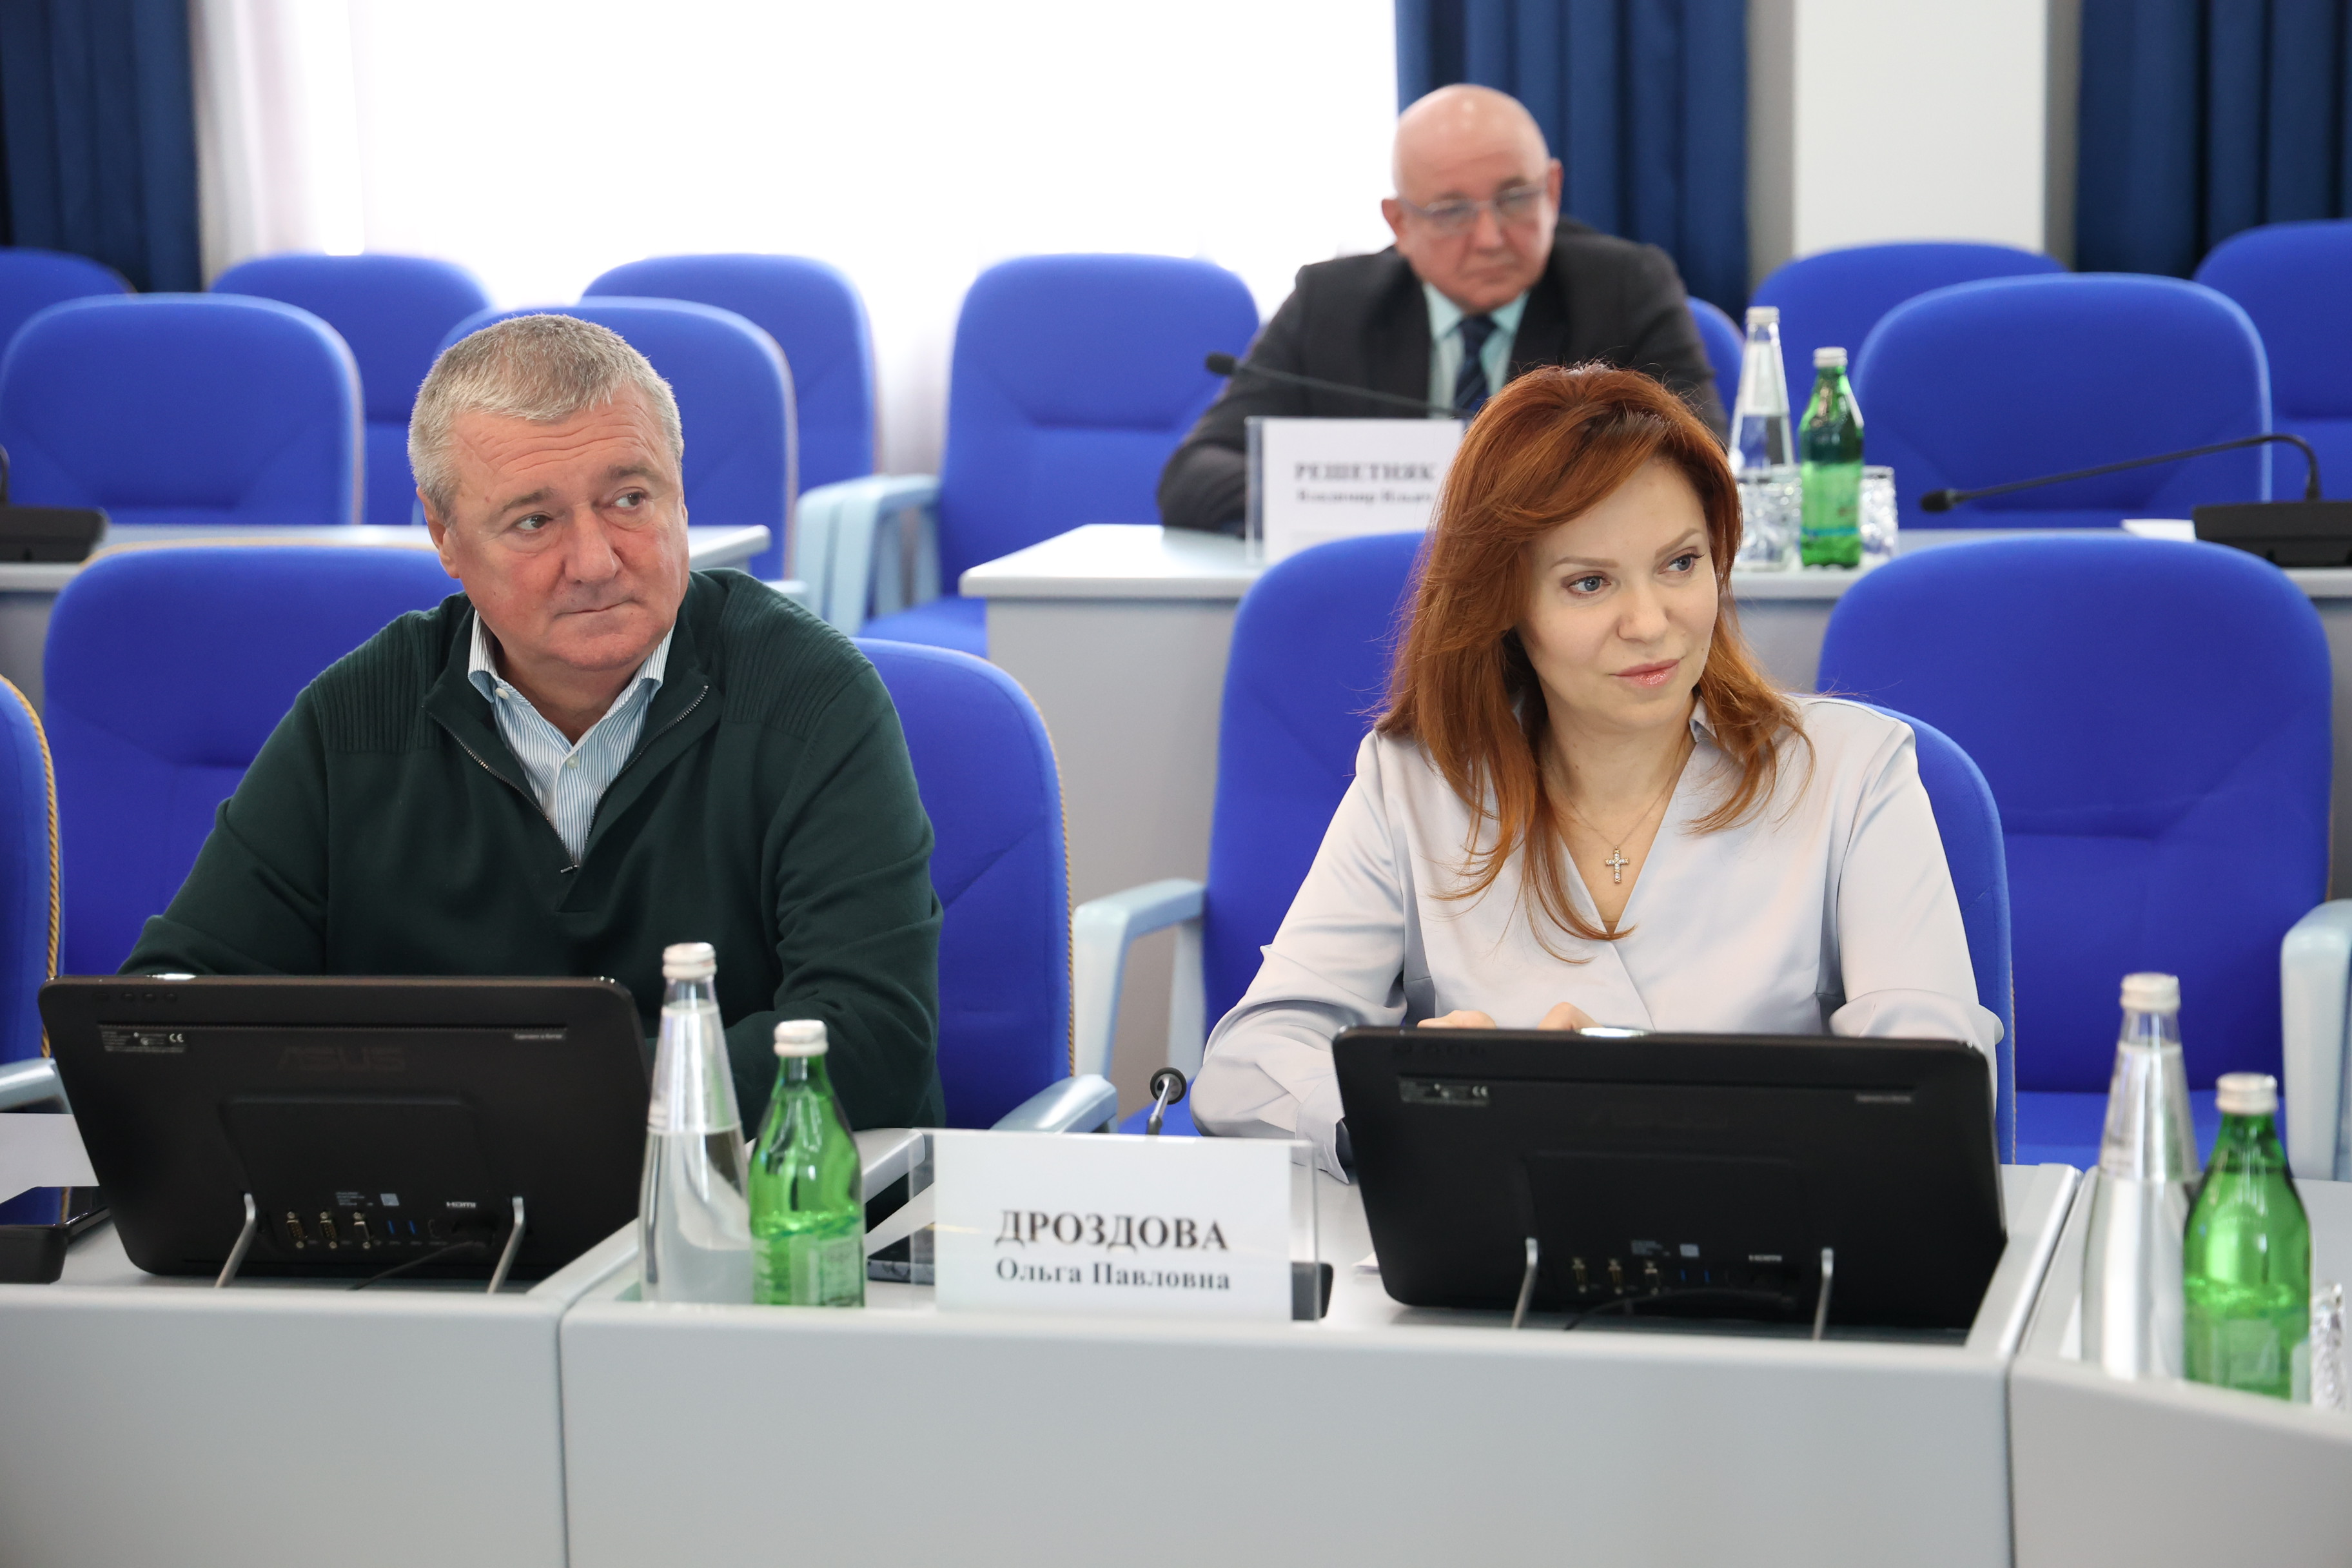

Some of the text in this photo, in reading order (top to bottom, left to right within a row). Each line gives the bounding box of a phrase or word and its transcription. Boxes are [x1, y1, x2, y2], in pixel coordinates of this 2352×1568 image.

[995, 1210, 1229, 1253] ДРОЗДОВА
[996, 1257, 1230, 1290] Ольга Павловна
